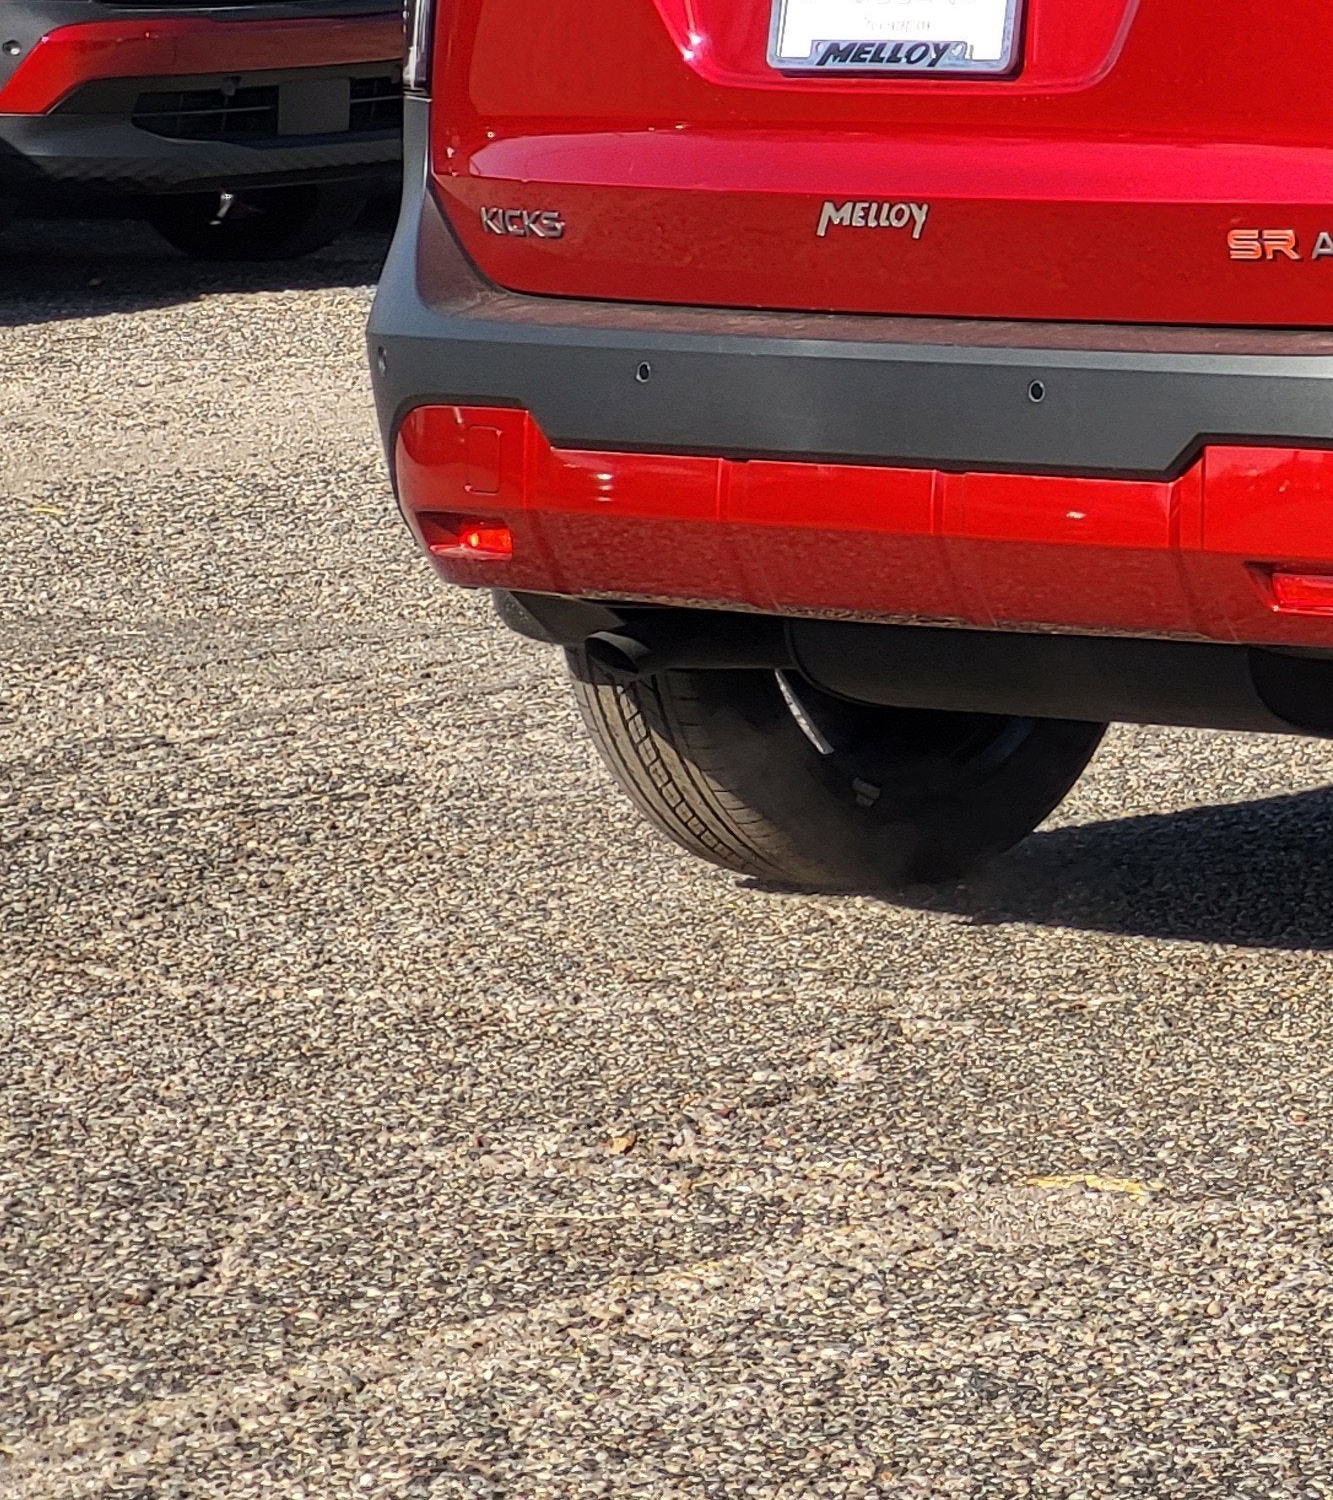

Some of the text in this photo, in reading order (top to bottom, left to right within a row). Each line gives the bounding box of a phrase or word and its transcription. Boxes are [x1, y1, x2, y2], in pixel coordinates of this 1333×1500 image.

[815, 42, 952, 67] MELLOY
[478, 205, 566, 239] KICKS
[815, 201, 930, 240] MELLOY
[1227, 229, 1301, 261] SR
